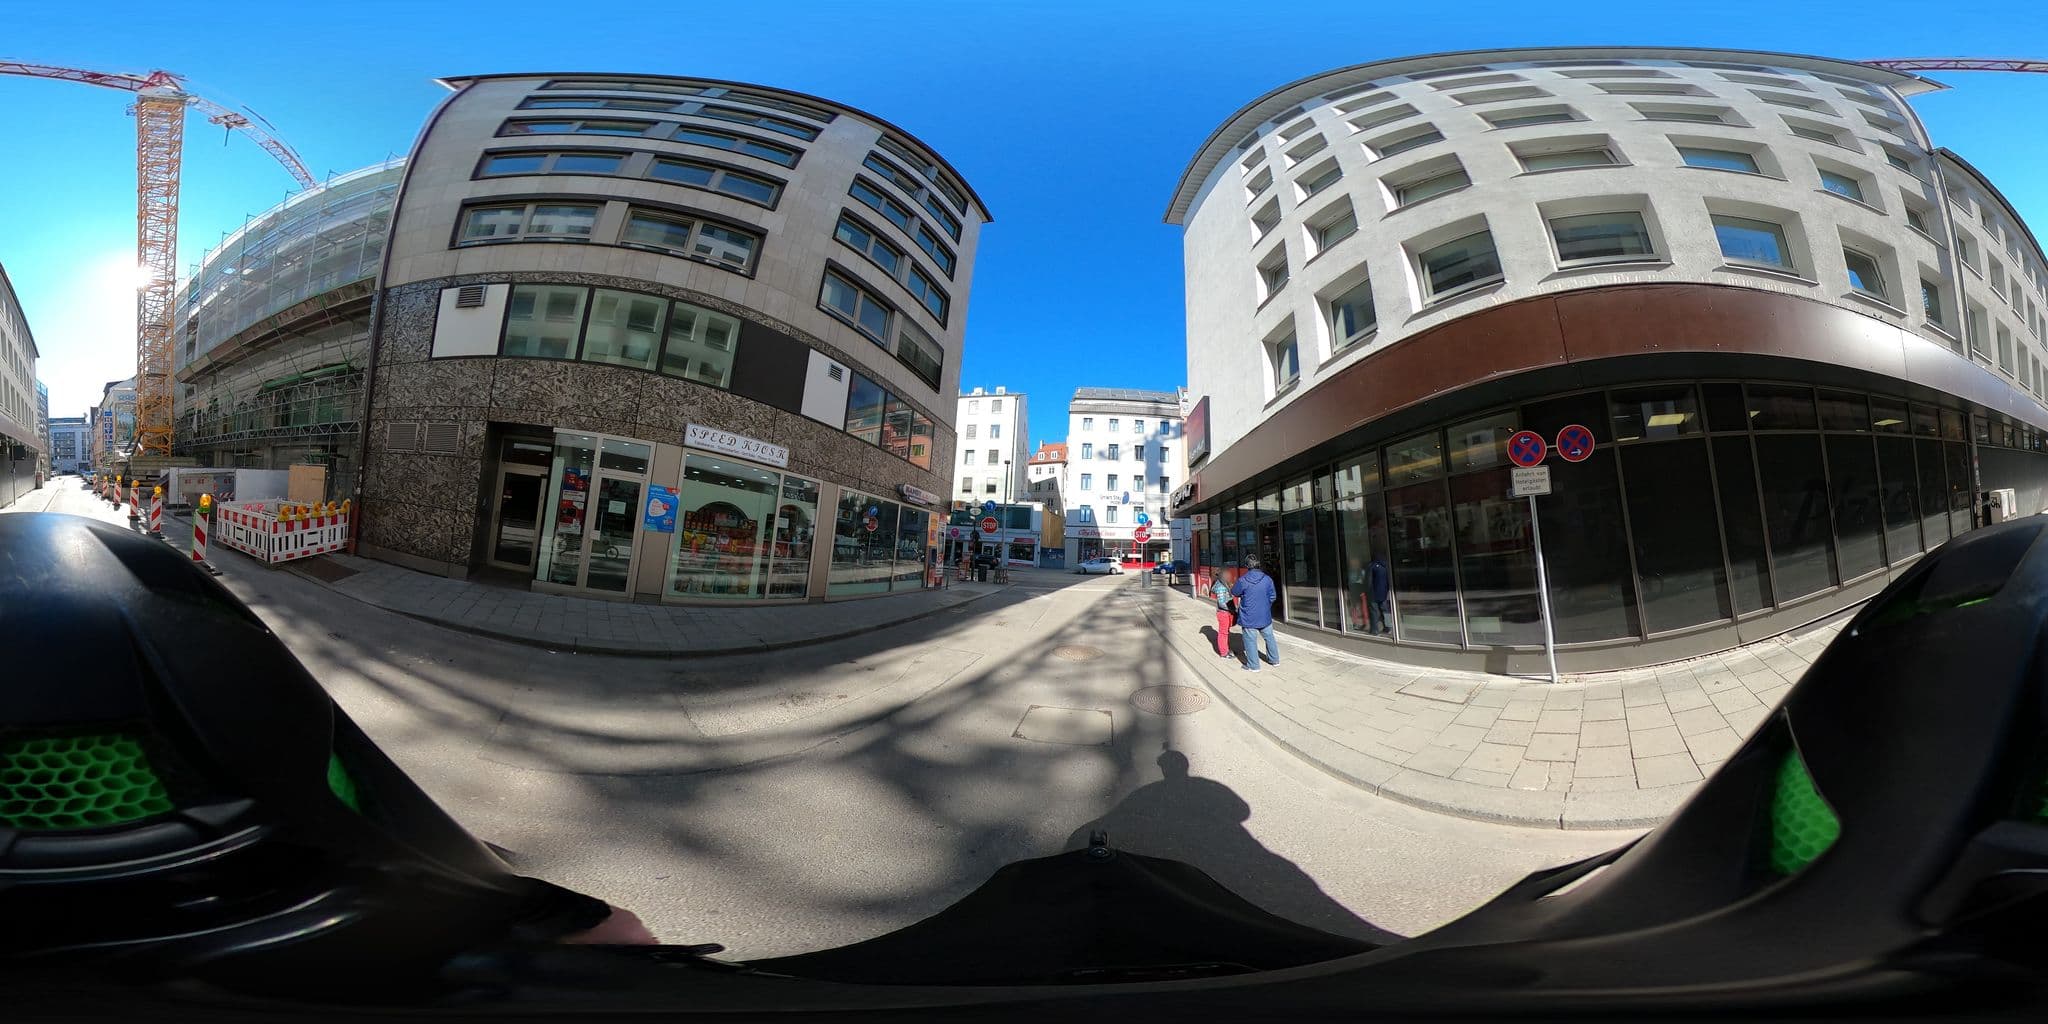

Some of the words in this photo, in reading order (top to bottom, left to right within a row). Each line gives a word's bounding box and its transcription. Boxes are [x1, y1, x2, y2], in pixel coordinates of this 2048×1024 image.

[690, 427, 737, 447] SPEED
[741, 440, 786, 460] KIOSK
[983, 521, 997, 530] STOP
